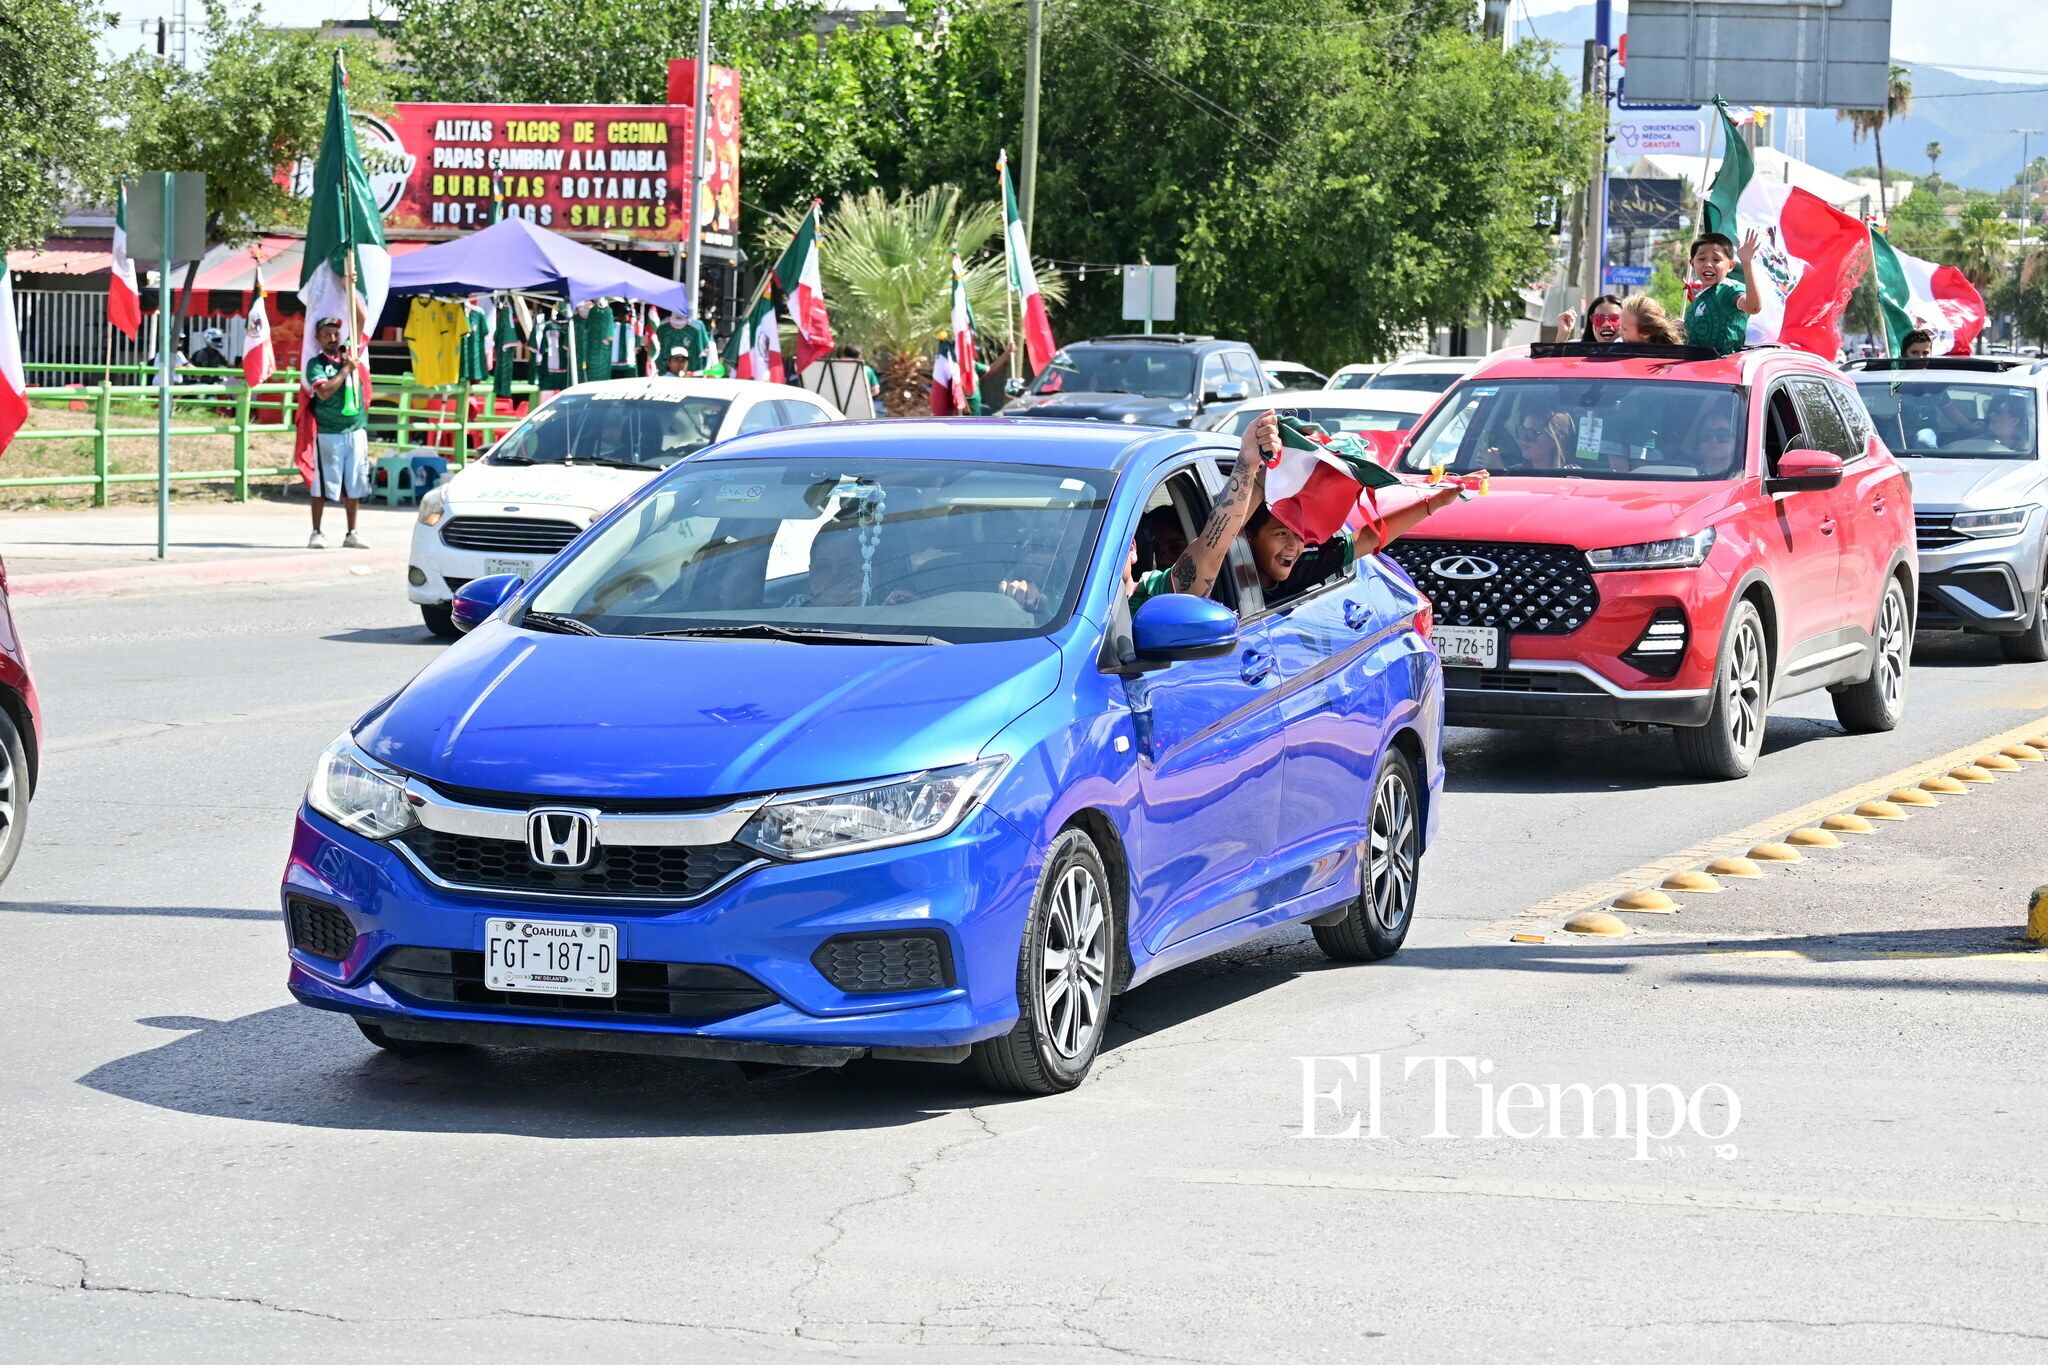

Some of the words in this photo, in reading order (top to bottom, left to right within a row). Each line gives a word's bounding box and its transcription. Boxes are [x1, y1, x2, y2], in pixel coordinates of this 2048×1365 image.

[434, 120, 493, 142] ALITAS
[506, 121, 561, 143] TACOS
[573, 122, 595, 143] DE
[607, 122, 668, 144] CECINA
[433, 148, 485, 169] PAPAS
[488, 148, 565, 171] CAMBRAY
[569, 149, 582, 171] A
[585, 149, 606, 171] LA
[610, 150, 667, 172] DIABLA
[432, 175, 545, 198] BURRTAS
[561, 177, 667, 199] BOTANAS
[432, 202, 553, 225] HOT-OGS
[570, 205, 667, 227] SNACKS
[522, 923, 578, 938] COAHUILA
[490, 937, 610, 974] FGT-187-D
